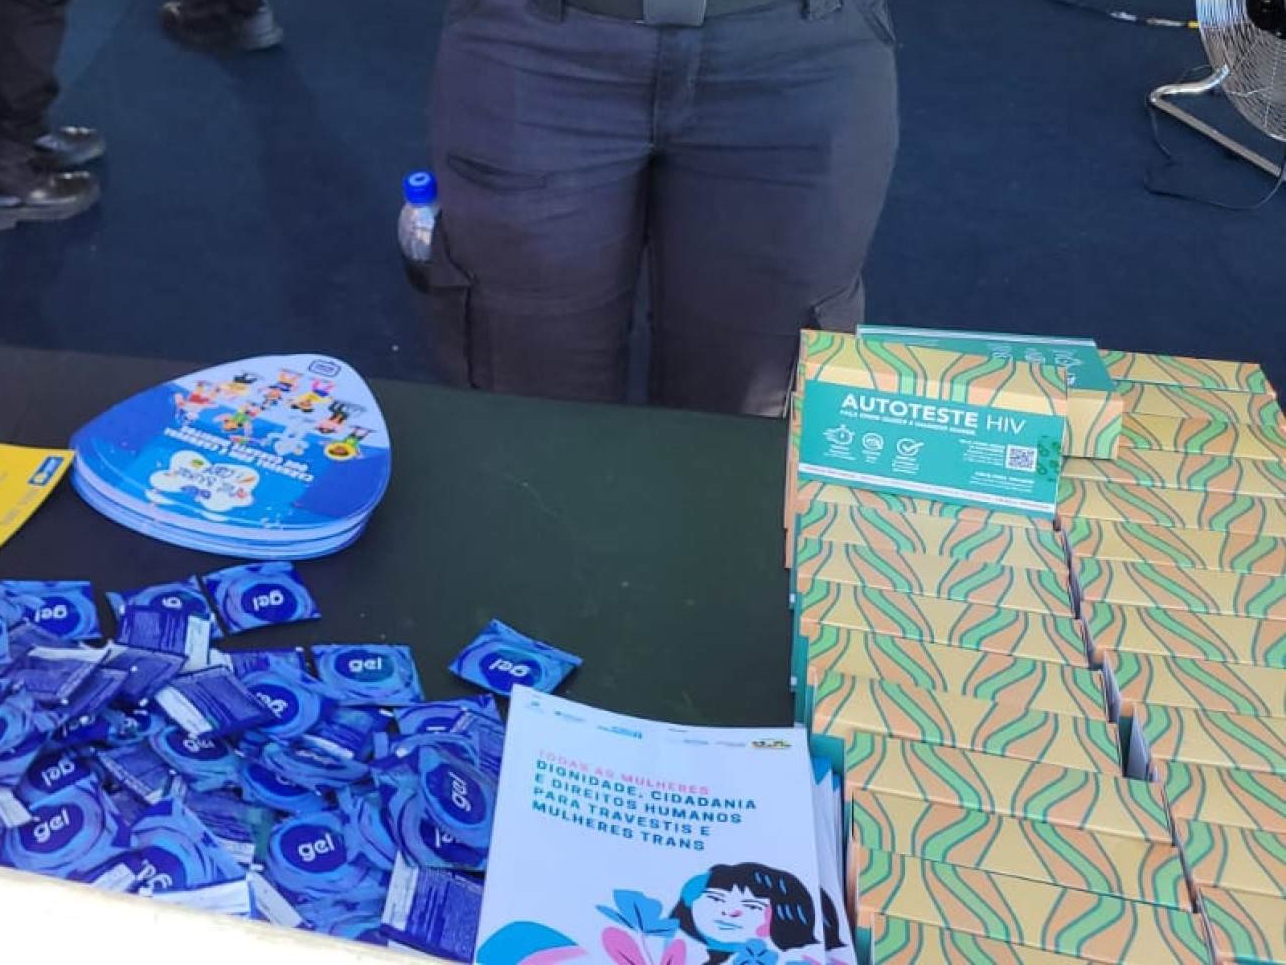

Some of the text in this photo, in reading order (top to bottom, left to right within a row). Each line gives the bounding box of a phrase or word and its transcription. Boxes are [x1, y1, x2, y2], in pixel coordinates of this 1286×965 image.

[841, 392, 978, 429] AUTOTESTE
[986, 413, 1027, 435] HIV
[35, 604, 67, 623] gel
[252, 589, 284, 611] gel
[348, 657, 382, 673] gel
[488, 658, 531, 677] gel
[42, 757, 75, 787] gel
[538, 749, 711, 796] TODAS AS MULHERES
[448, 771, 472, 812] gel
[534, 772, 743, 824] E DIREITOS HUMANOS
[650, 789, 757, 811] CIDADANIA
[33, 808, 70, 844] gel
[531, 800, 706, 852] MULHERES TRANS
[533, 787, 711, 836] PARA TRAVESTIS E
[297, 832, 335, 862] gel
